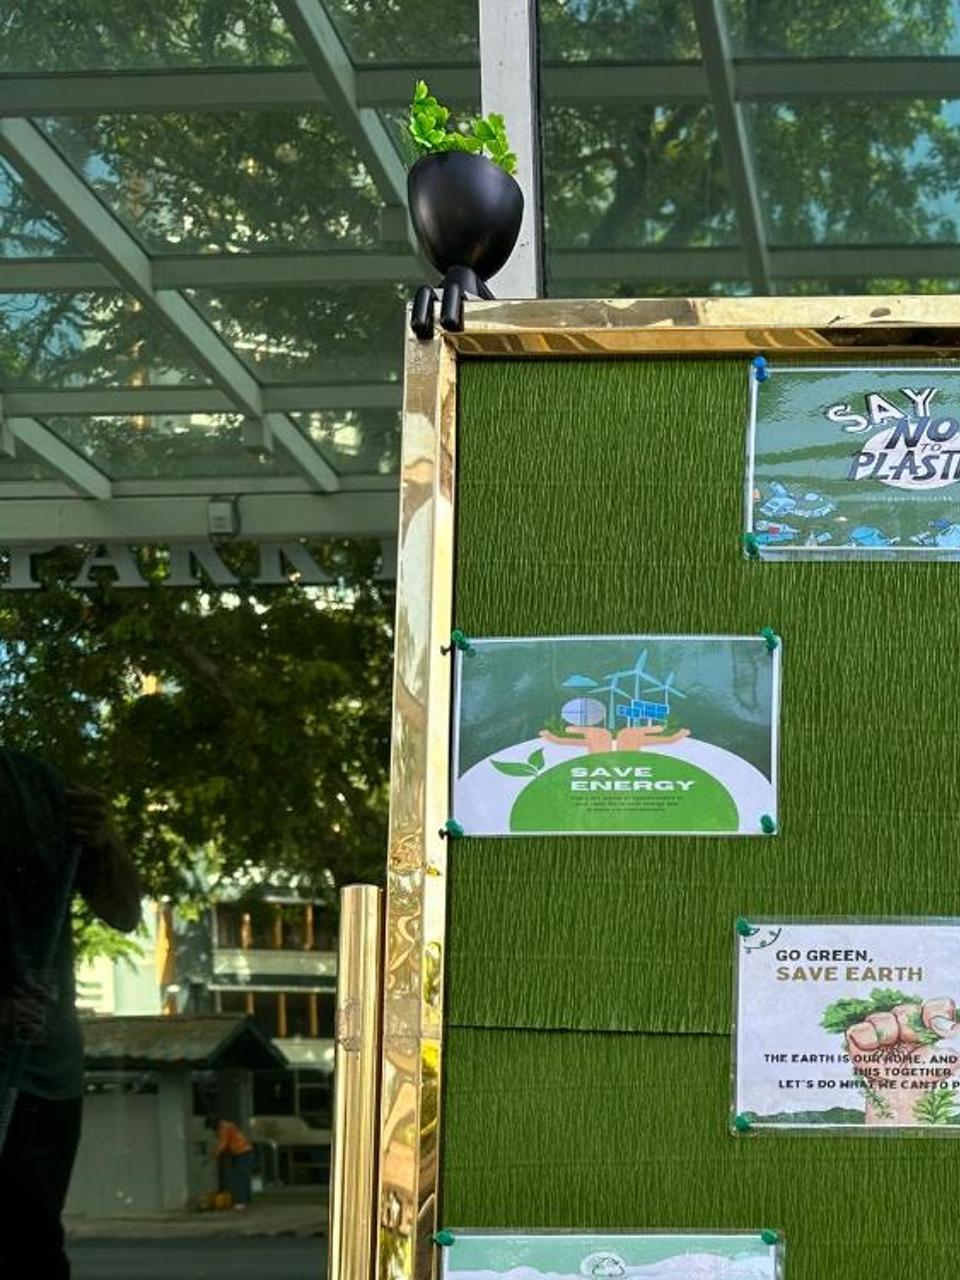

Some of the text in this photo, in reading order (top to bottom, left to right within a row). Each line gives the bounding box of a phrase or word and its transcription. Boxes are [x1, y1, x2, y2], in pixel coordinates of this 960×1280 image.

[826, 387, 938, 433] SAY
[884, 415, 960, 450] NO
[920, 443, 943, 452] TO
[570, 767, 654, 779] SAVE
[570, 780, 695, 792] ENERGY
[775, 949, 874, 963] GO GREEN,
[776, 966, 923, 982] SAVE EARTH
[764, 1054, 788, 1064] THE
[791, 1054, 836, 1064] EARTH
[837, 1054, 850, 1064] IS
[854, 1054, 880, 1064] OUR
[930, 1054, 959, 1064] AND
[853, 1067, 881, 1077] THIS
[779, 1080, 814, 1089] LET'S
[818, 1080, 836, 1089] DO
[839, 1080, 874, 1090] WHAT
[879, 1080, 897, 1090] WE
